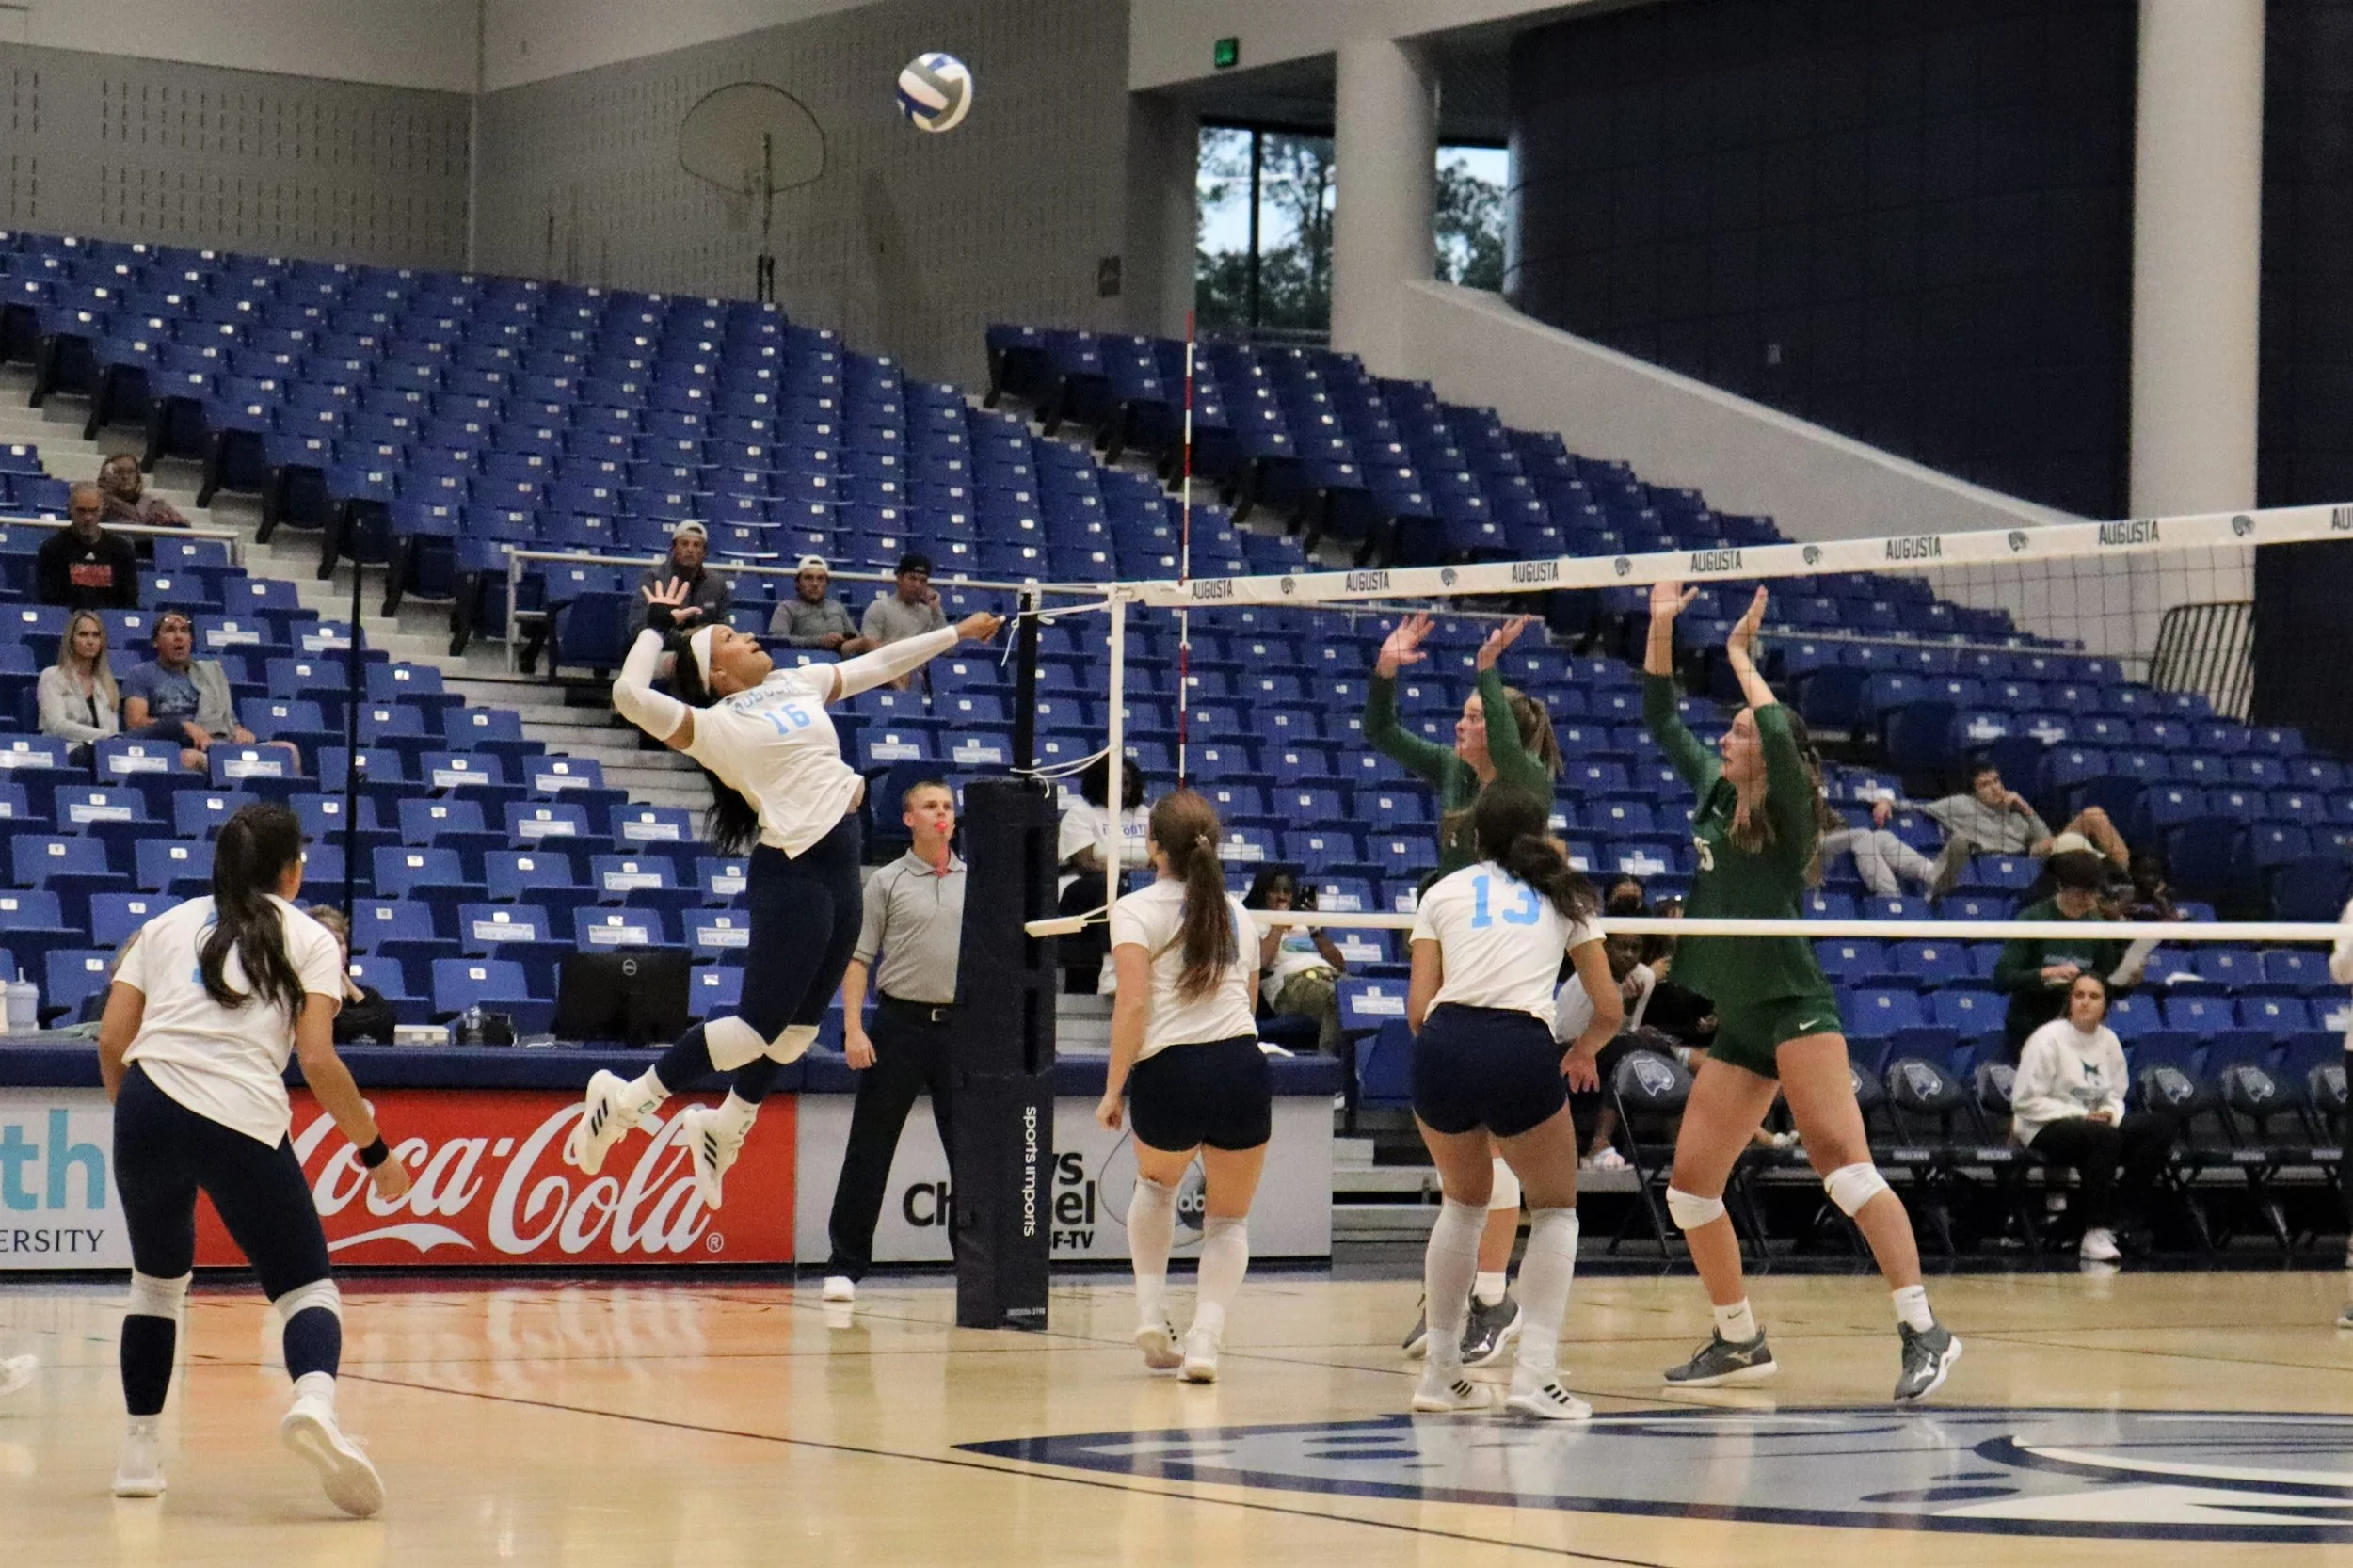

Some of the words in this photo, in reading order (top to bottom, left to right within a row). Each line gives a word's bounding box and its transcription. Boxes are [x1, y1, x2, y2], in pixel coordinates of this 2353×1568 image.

[2098, 520, 2160, 546] AUGUSTA
[1690, 550, 1743, 572] AUGUSTA
[1885, 536, 1942, 561] AUGUSTA
[1345, 571, 1390, 592] AUGUSTA
[1512, 562, 1559, 584] AUGUSTA
[1192, 579, 1234, 600] AUGUSTA
[764, 703, 811, 735] 16
[1471, 875, 1541, 930] 13
[1022, 1106, 1038, 1163] sports
[1021, 1166, 1036, 1237] imports
